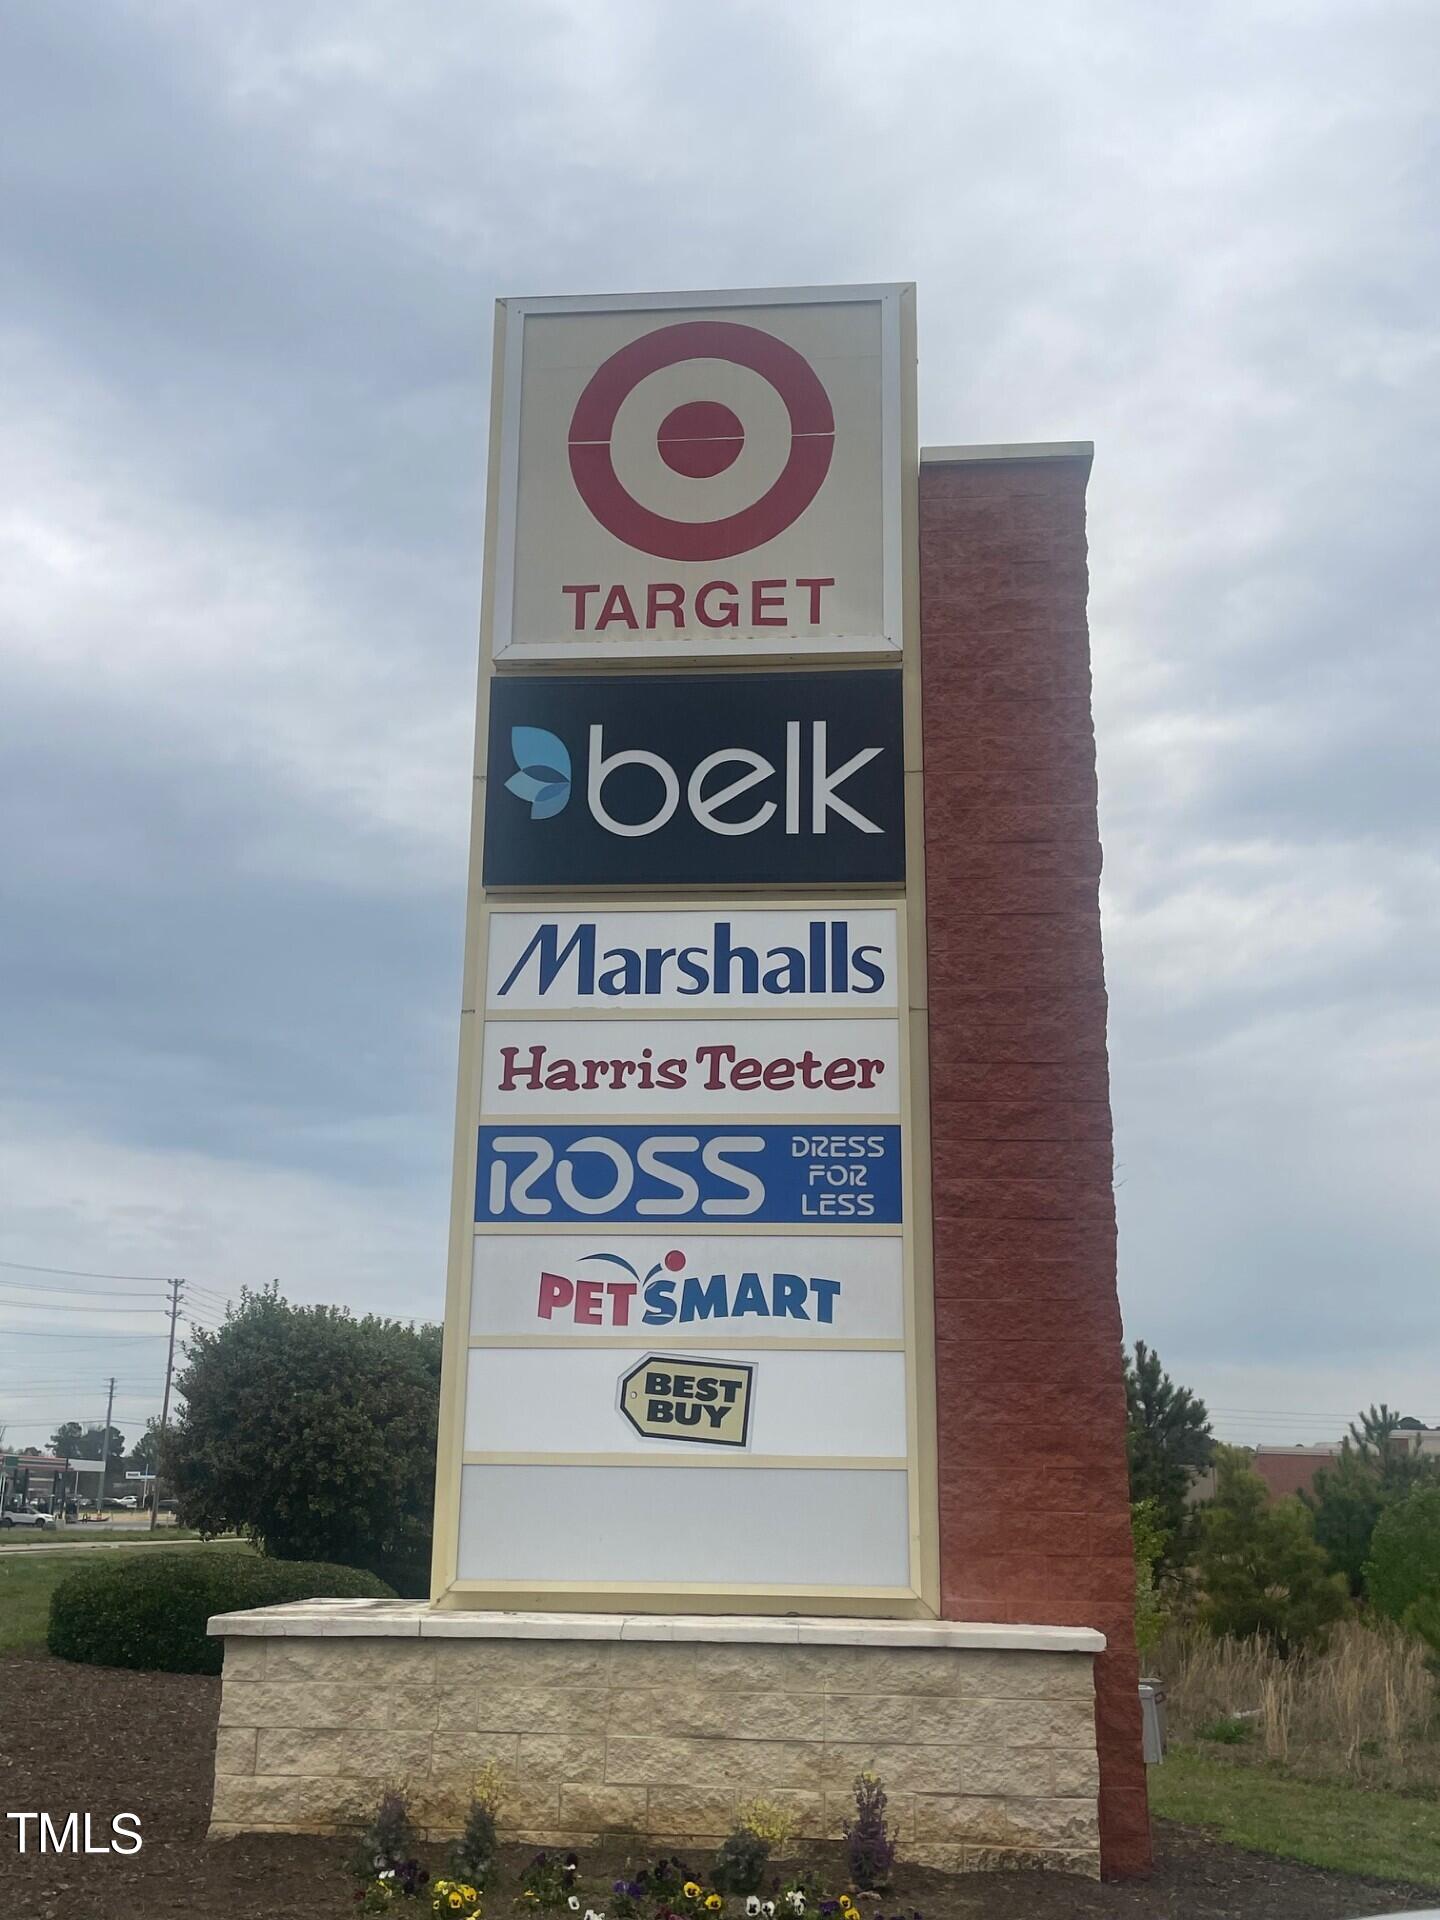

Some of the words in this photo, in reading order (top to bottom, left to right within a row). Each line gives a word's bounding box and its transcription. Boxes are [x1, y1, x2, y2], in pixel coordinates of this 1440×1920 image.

[562, 578, 835, 631] TARGET
[587, 720, 885, 837] belk
[497, 921, 885, 996] Marshalls
[498, 1045, 687, 1092] Harris
[696, 1044, 885, 1091] Teeter
[791, 1136, 885, 1158] DRESS
[489, 1136, 766, 1216] ROSS
[808, 1164, 868, 1187] FOR
[802, 1193, 875, 1216] LESS
[537, 1271, 841, 1326] PETSMART
[644, 1371, 742, 1404] BEST
[646, 1399, 732, 1428] BUY
